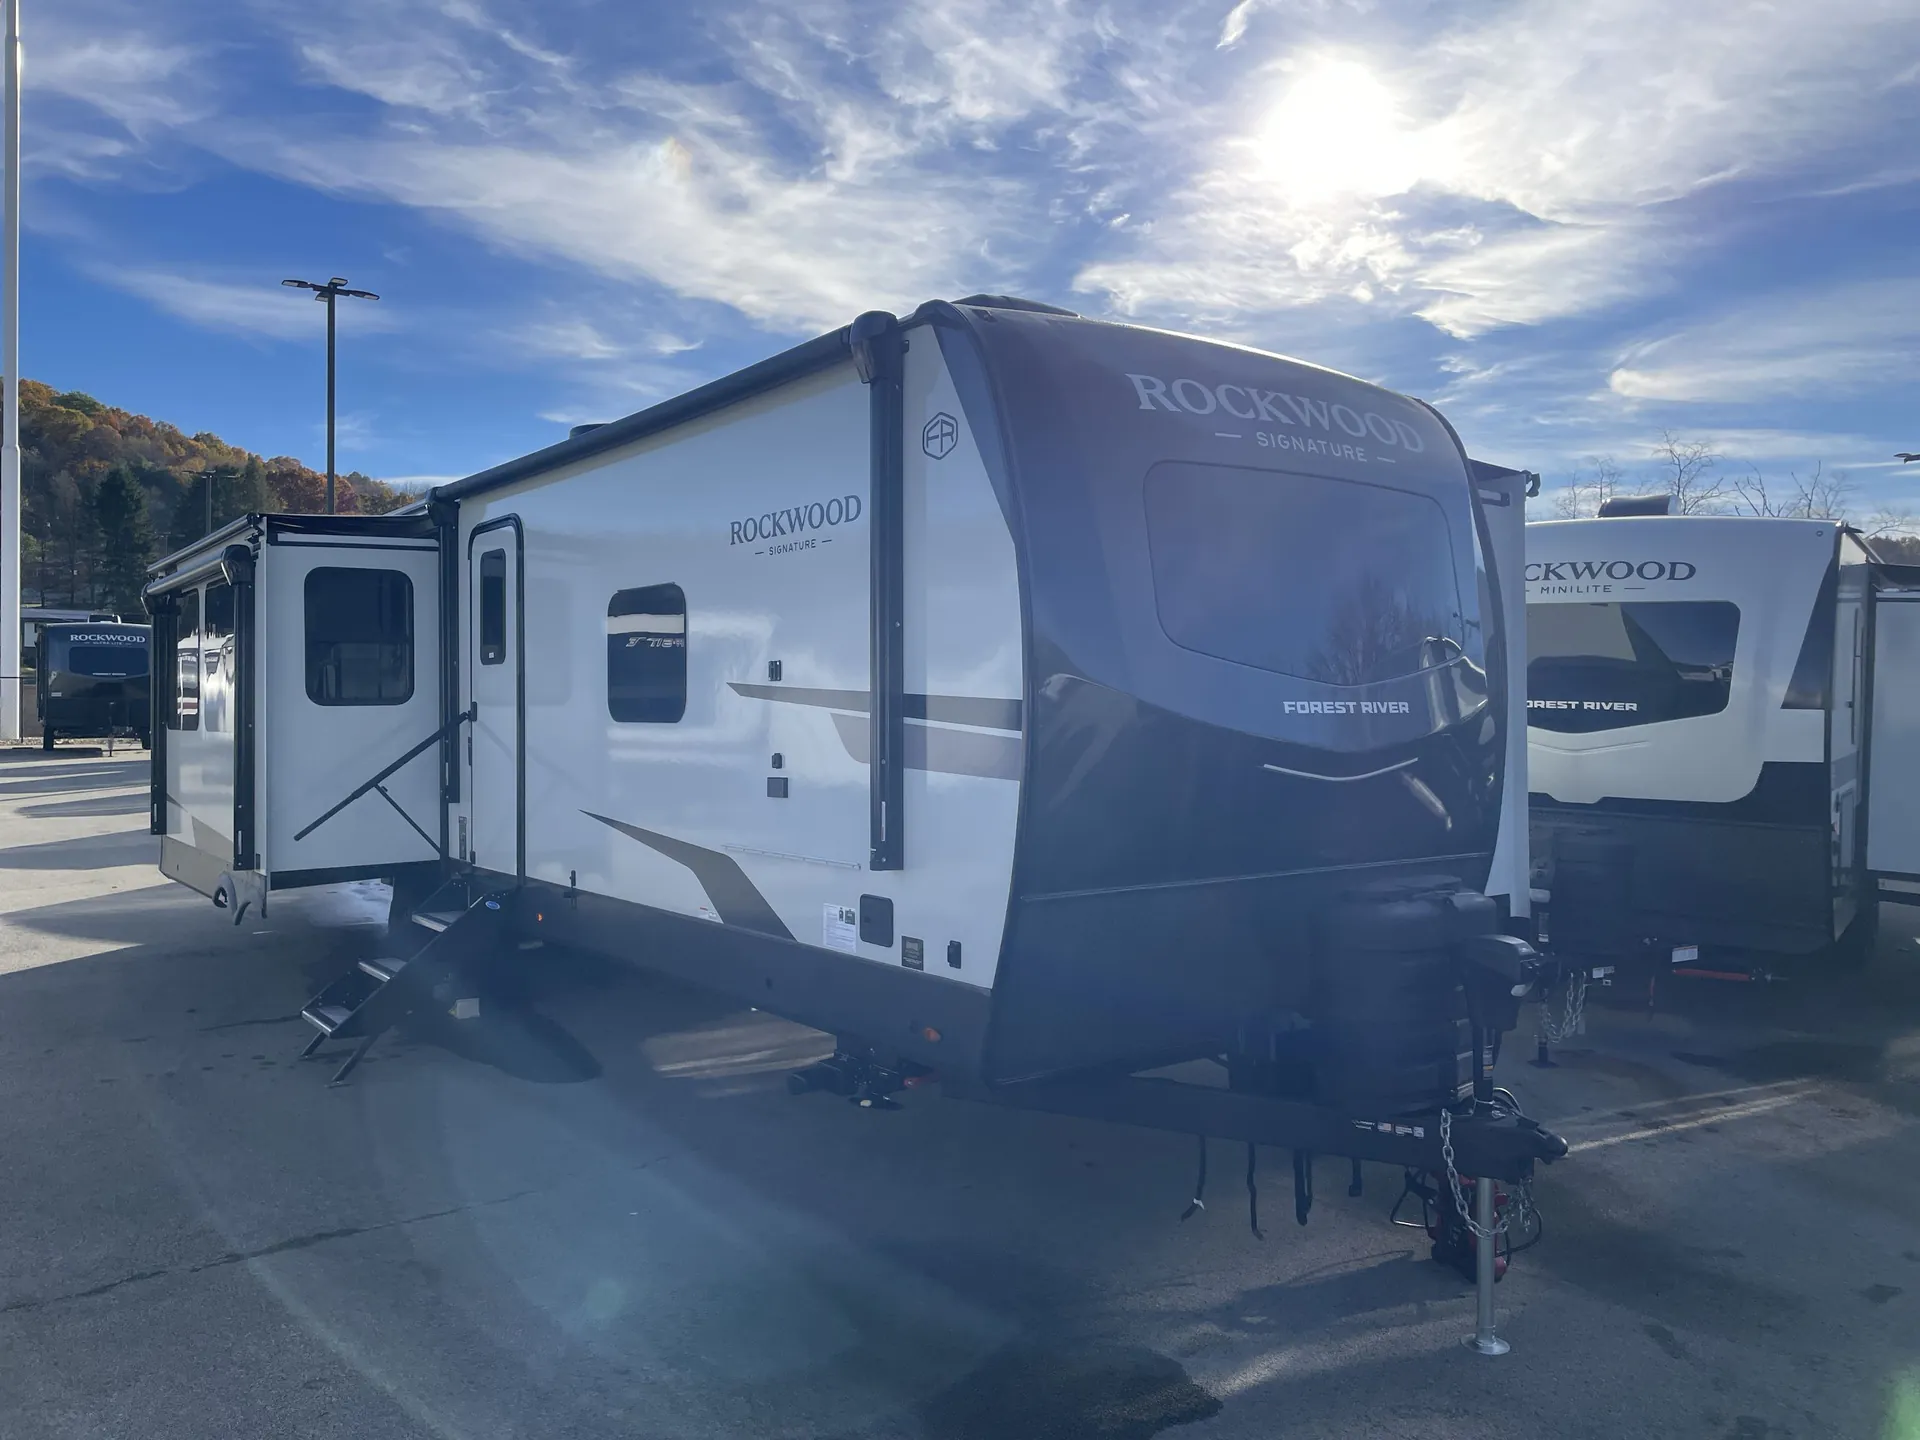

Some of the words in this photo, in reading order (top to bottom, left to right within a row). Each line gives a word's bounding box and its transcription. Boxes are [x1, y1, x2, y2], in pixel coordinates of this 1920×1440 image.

[1124, 372, 1424, 453] ROCKWOOD
[1255, 431, 1368, 462] SIGNATURE
[729, 494, 862, 546] ROCKWOOD
[768, 538, 817, 556] SIGNATURE
[1525, 560, 1697, 582] CKWOOD
[1540, 584, 1613, 595] MINILITE
[69, 634, 146, 643] ROCKWOOD
[1283, 701, 1357, 714] FOREST
[1360, 701, 1410, 714] RIVER
[1526, 700, 1579, 709] OREST
[1583, 701, 1638, 712] RIVER
